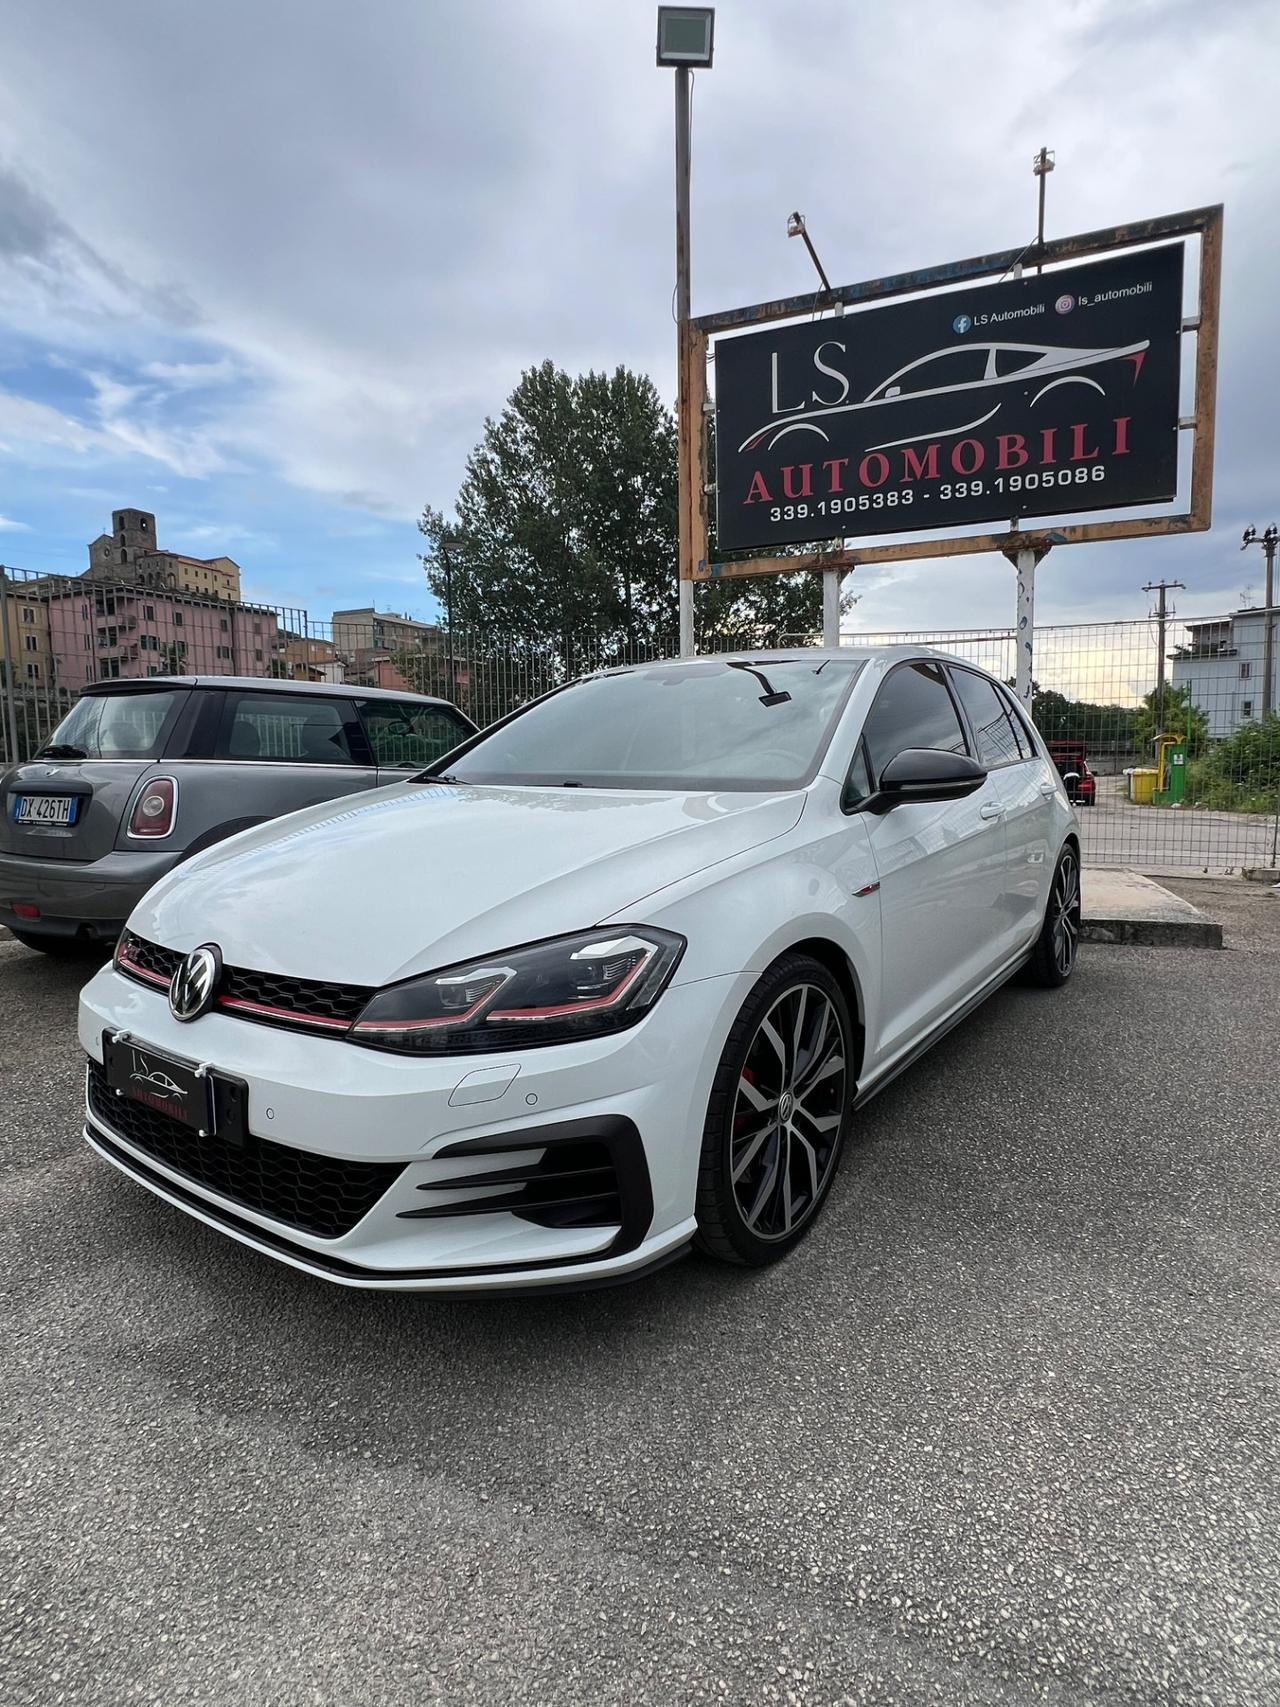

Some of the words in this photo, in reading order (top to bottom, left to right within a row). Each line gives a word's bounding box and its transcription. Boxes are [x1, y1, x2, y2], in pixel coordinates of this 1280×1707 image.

[973, 314, 988, 326] LS
[990, 303, 1045, 323] Automobili
[1078, 281, 1153, 307] ls_automobili
[771, 341, 850, 414] LS
[743, 416, 1132, 505] AUTOMOBILI
[770, 489, 914, 522] 339.1905383
[939, 465, 1106, 500] 339.1905086
[20, 798, 34, 818] DX
[36, 799, 70, 820] 426TH
